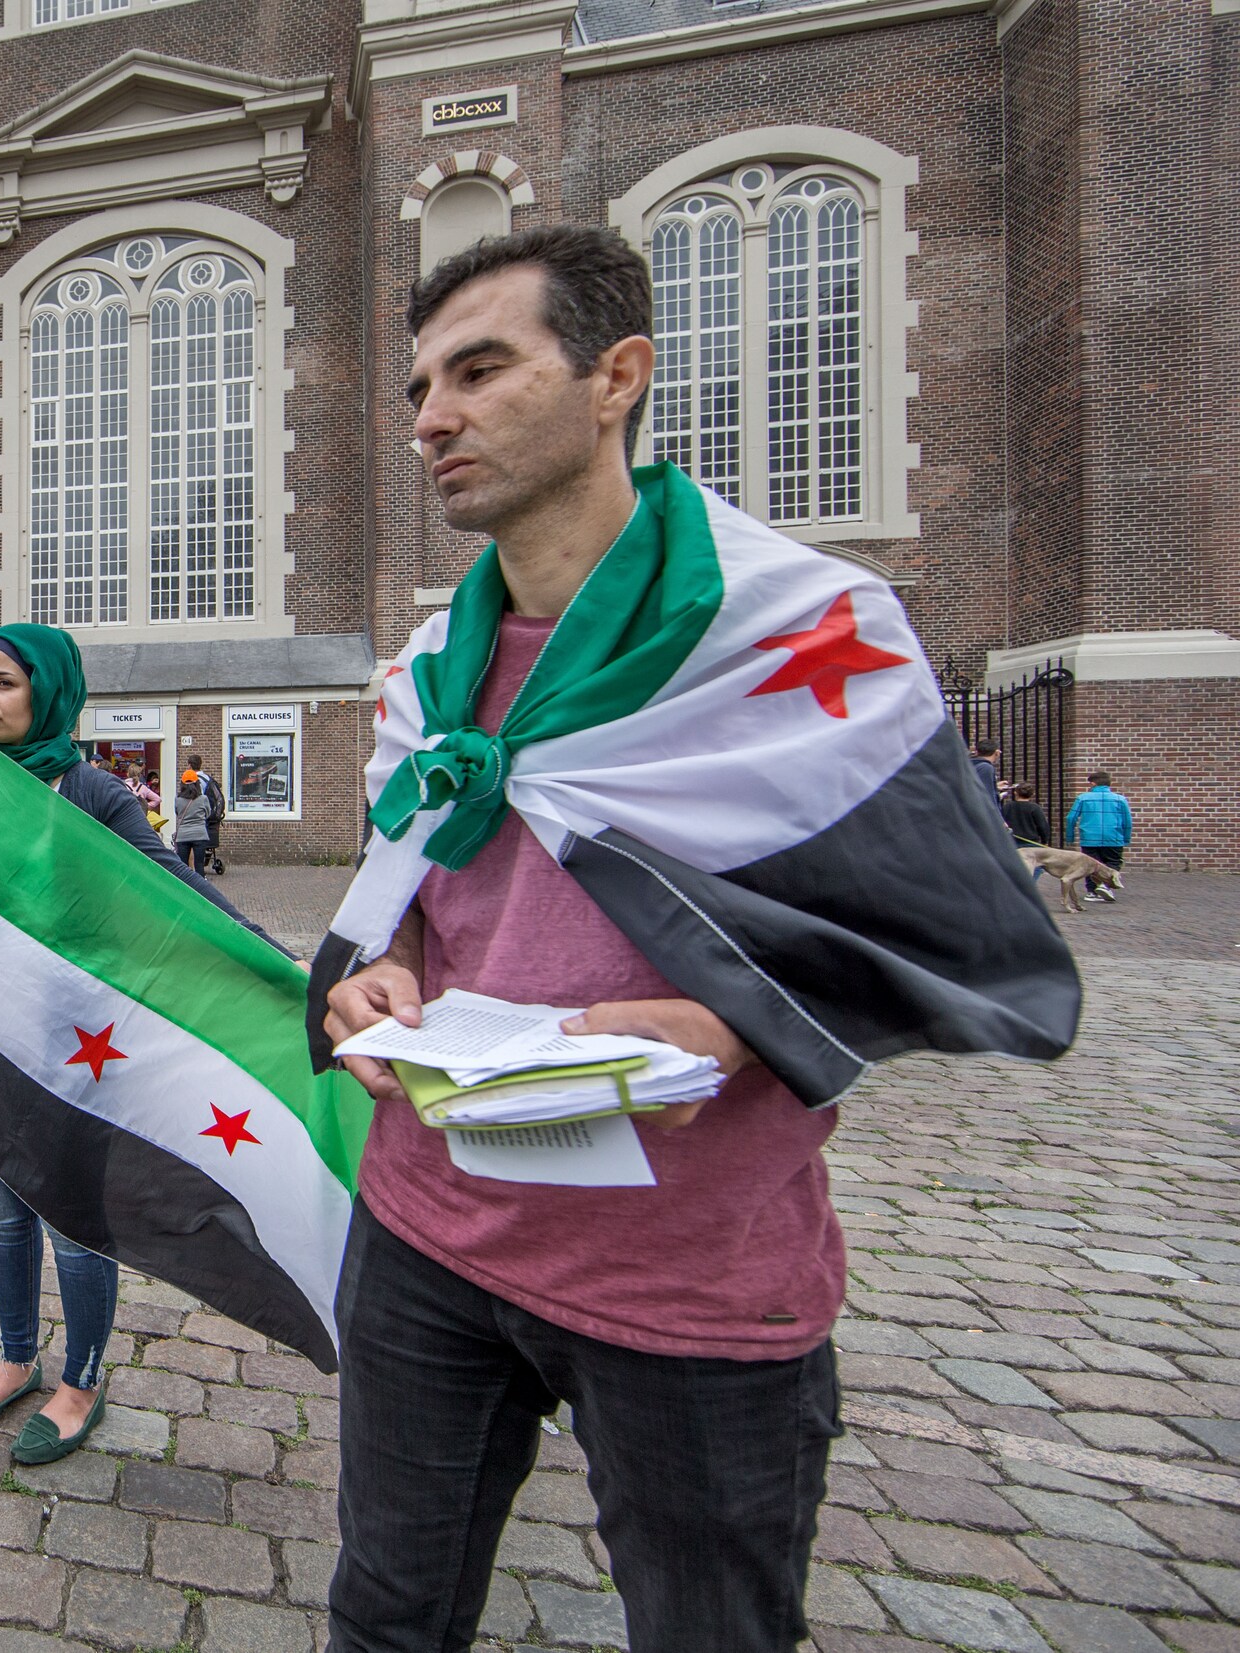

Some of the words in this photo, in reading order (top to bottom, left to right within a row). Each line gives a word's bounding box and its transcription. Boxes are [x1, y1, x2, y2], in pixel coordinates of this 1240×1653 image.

[112, 714, 143, 722] TICKETS
[231, 713, 257, 721] CANAL
[258, 712, 292, 720] CRUISES
